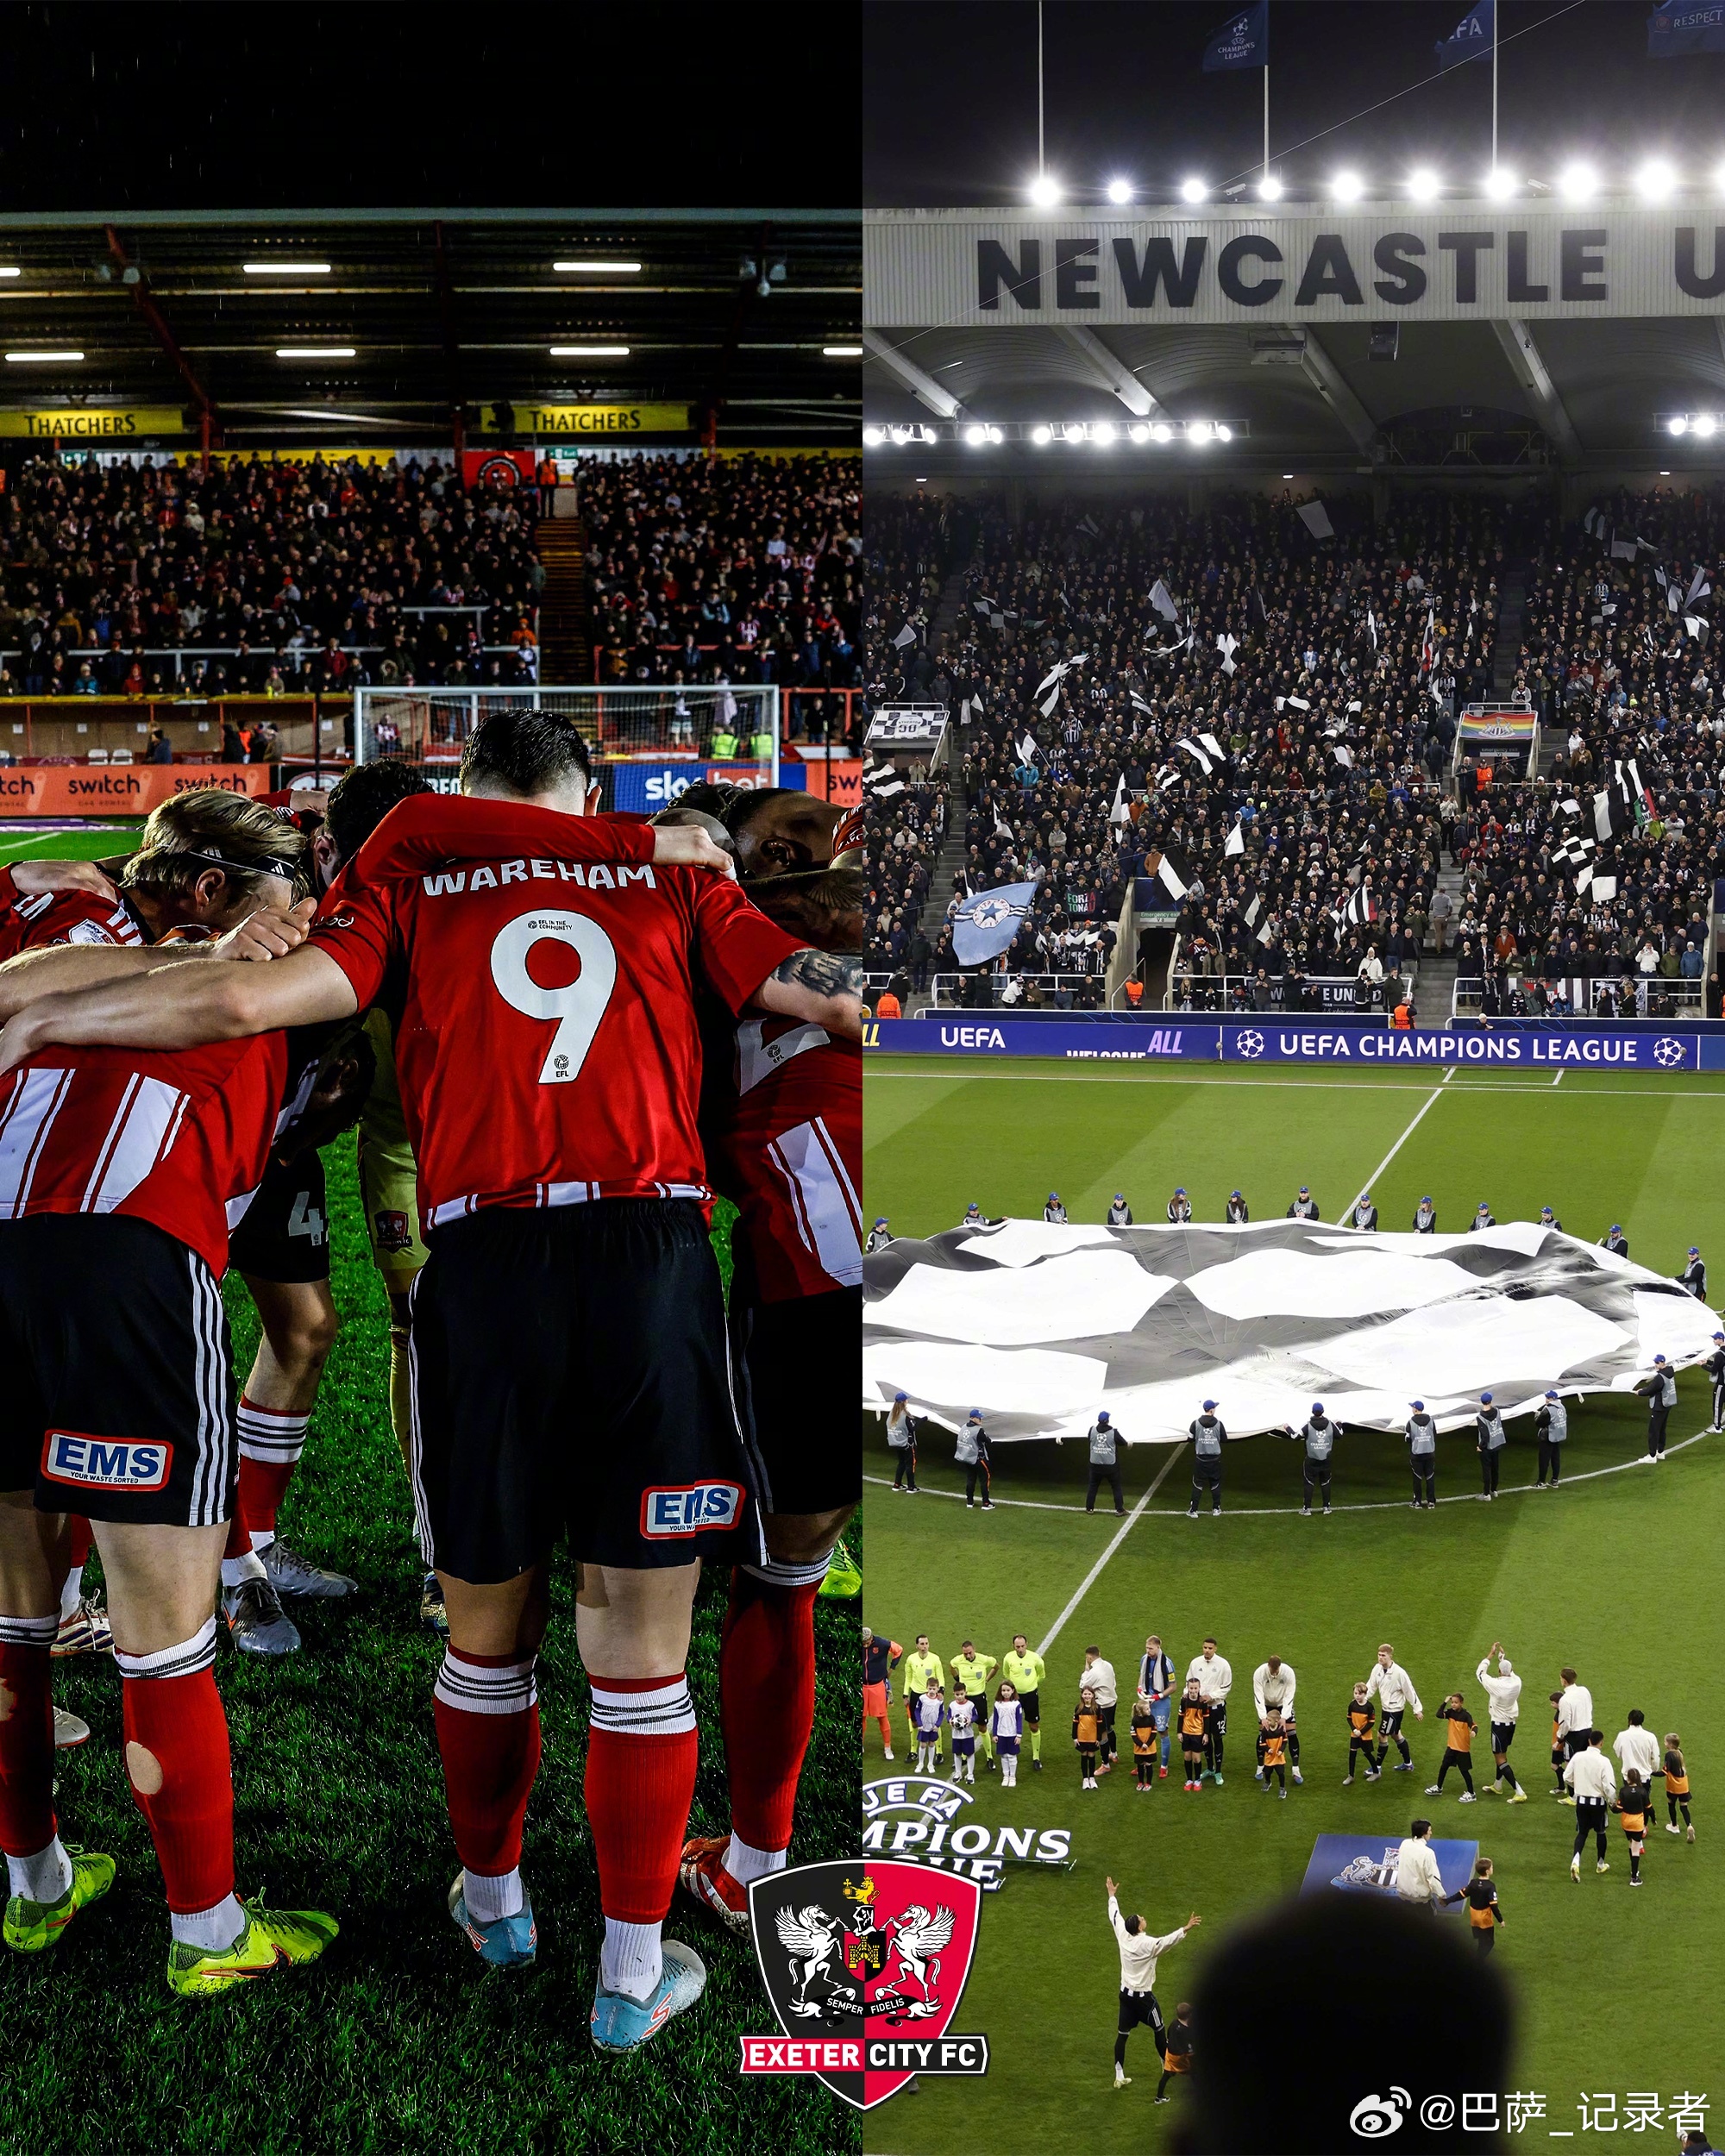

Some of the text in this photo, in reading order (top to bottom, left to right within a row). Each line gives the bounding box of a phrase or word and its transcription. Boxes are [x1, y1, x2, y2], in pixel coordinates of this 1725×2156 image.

[1449, 17, 1483, 40] FA
[1673, 9, 1723, 28] RESPECT
[1225, 50, 1247, 60] LEAGUE
[977, 226, 1725, 310] NEWCASTLE U
[24, 414, 135, 436] THATCHERS
[528, 410, 641, 430] THATCHERS
[68, 774, 140, 794] switch
[1640, 794, 1650, 812] 8
[423, 859, 656, 896] WAREHAM
[491, 909, 618, 1084] 9
[941, 1027, 1006, 1049] UEFA
[1147, 1031, 1182, 1054] ALL
[1280, 1035, 1638, 1062] UEFA CHAMPIONS LEAGUE
[773, 1055, 785, 1064] EFL
[55, 1437, 160, 1478] EMS
[71, 1471, 89, 1480] YOUR
[90, 1474, 113, 1482] WASTE
[655, 1488, 731, 1525] EMS
[1157, 1715, 1166, 1725] 32
[1217, 1720, 1226, 1730] 12
[1382, 1720, 1388, 1729] 3
